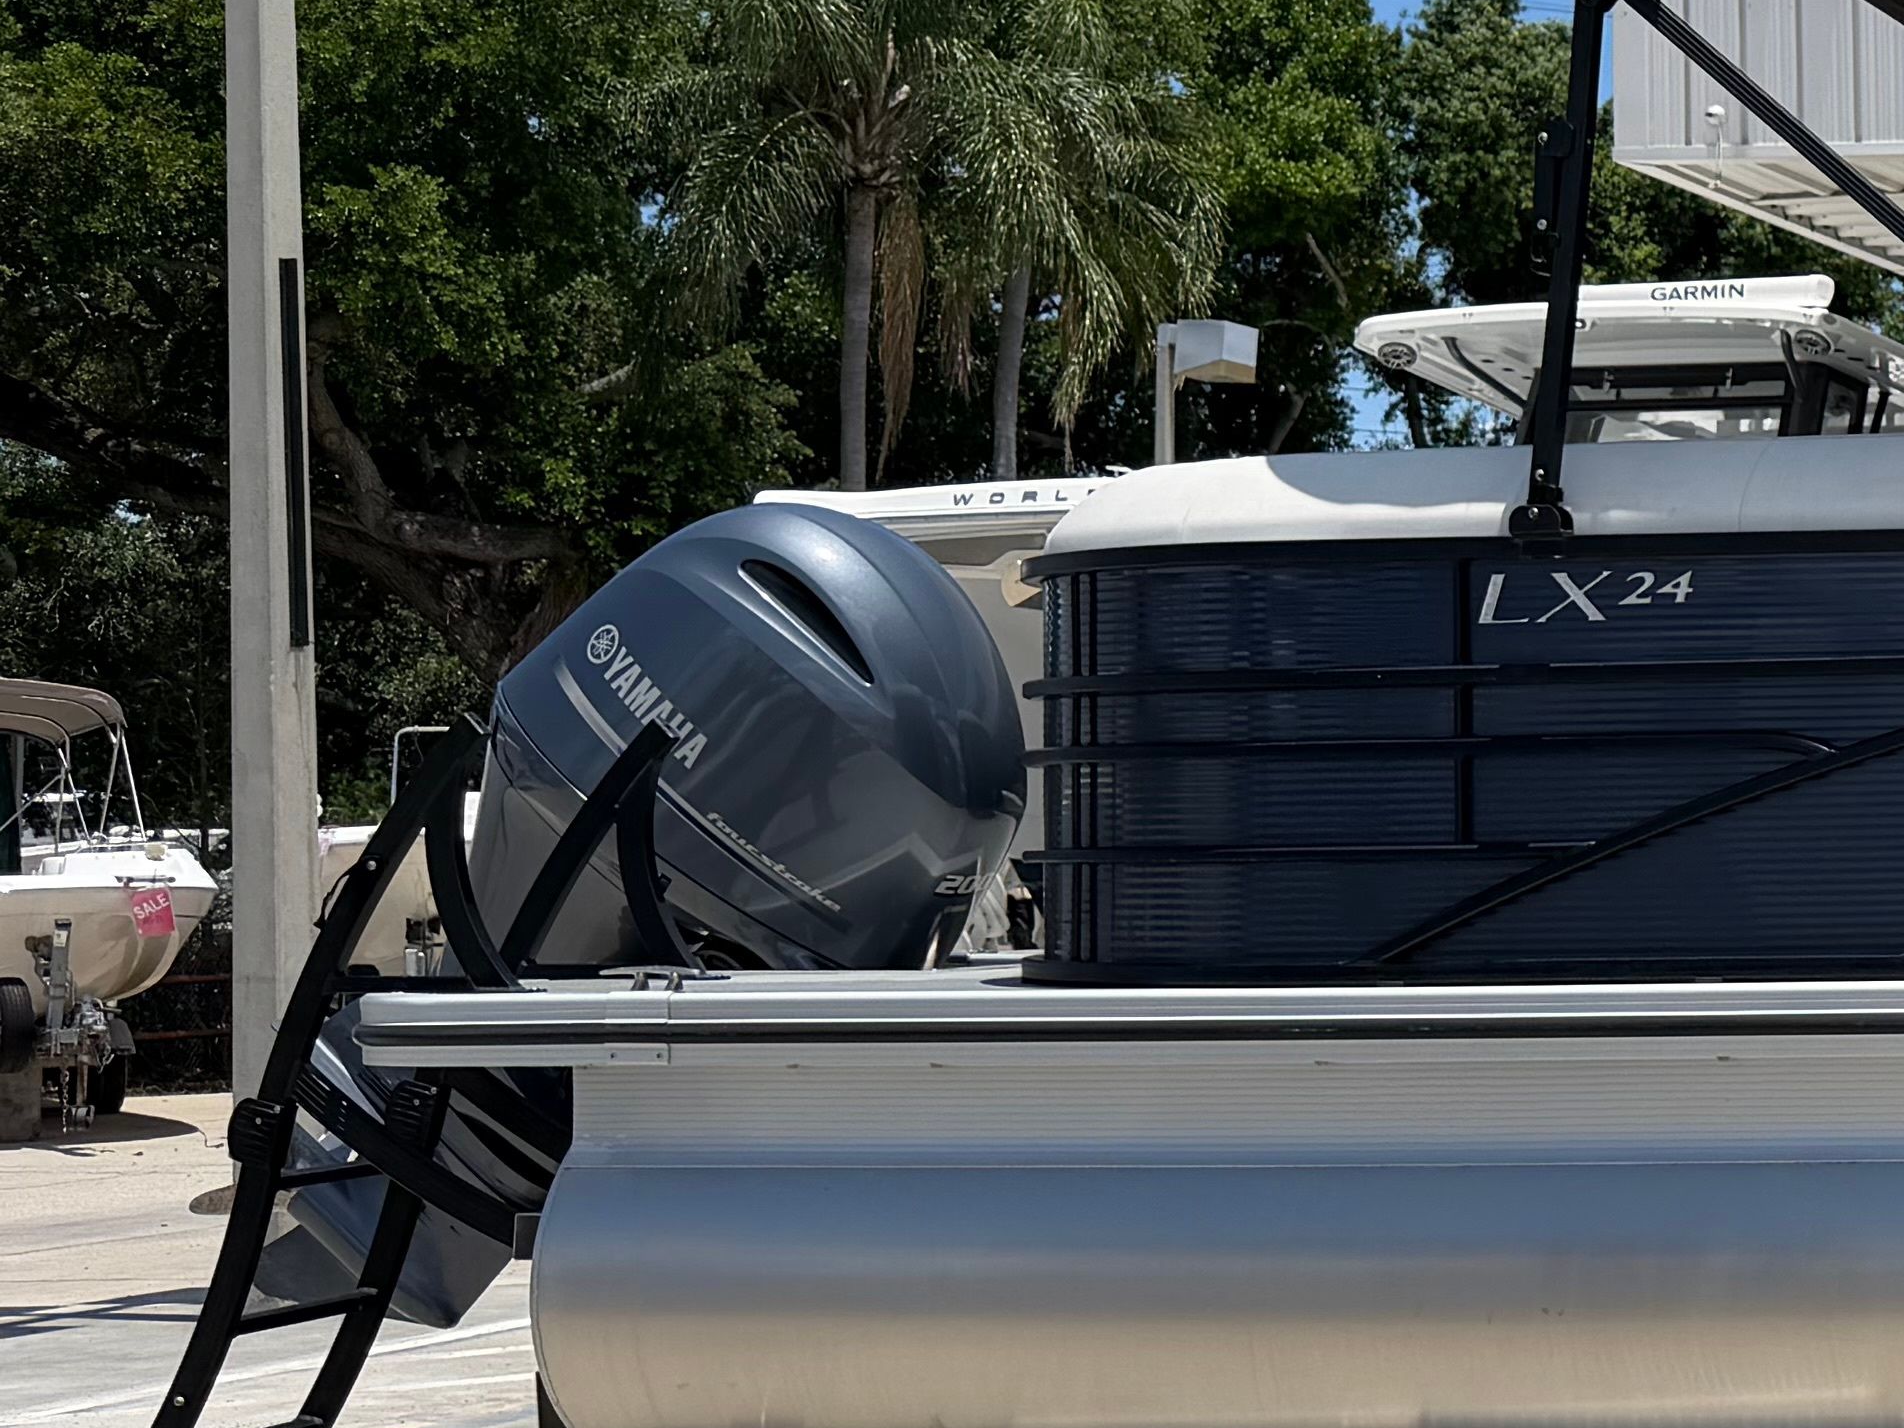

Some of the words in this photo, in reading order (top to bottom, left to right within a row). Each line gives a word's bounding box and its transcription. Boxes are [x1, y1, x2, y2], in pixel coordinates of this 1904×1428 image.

[1650, 283, 1745, 301] GARMIN
[953, 488, 1096, 506] WORL
[603, 645, 708, 770] YAMAHA
[133, 892, 170, 919] SALE
